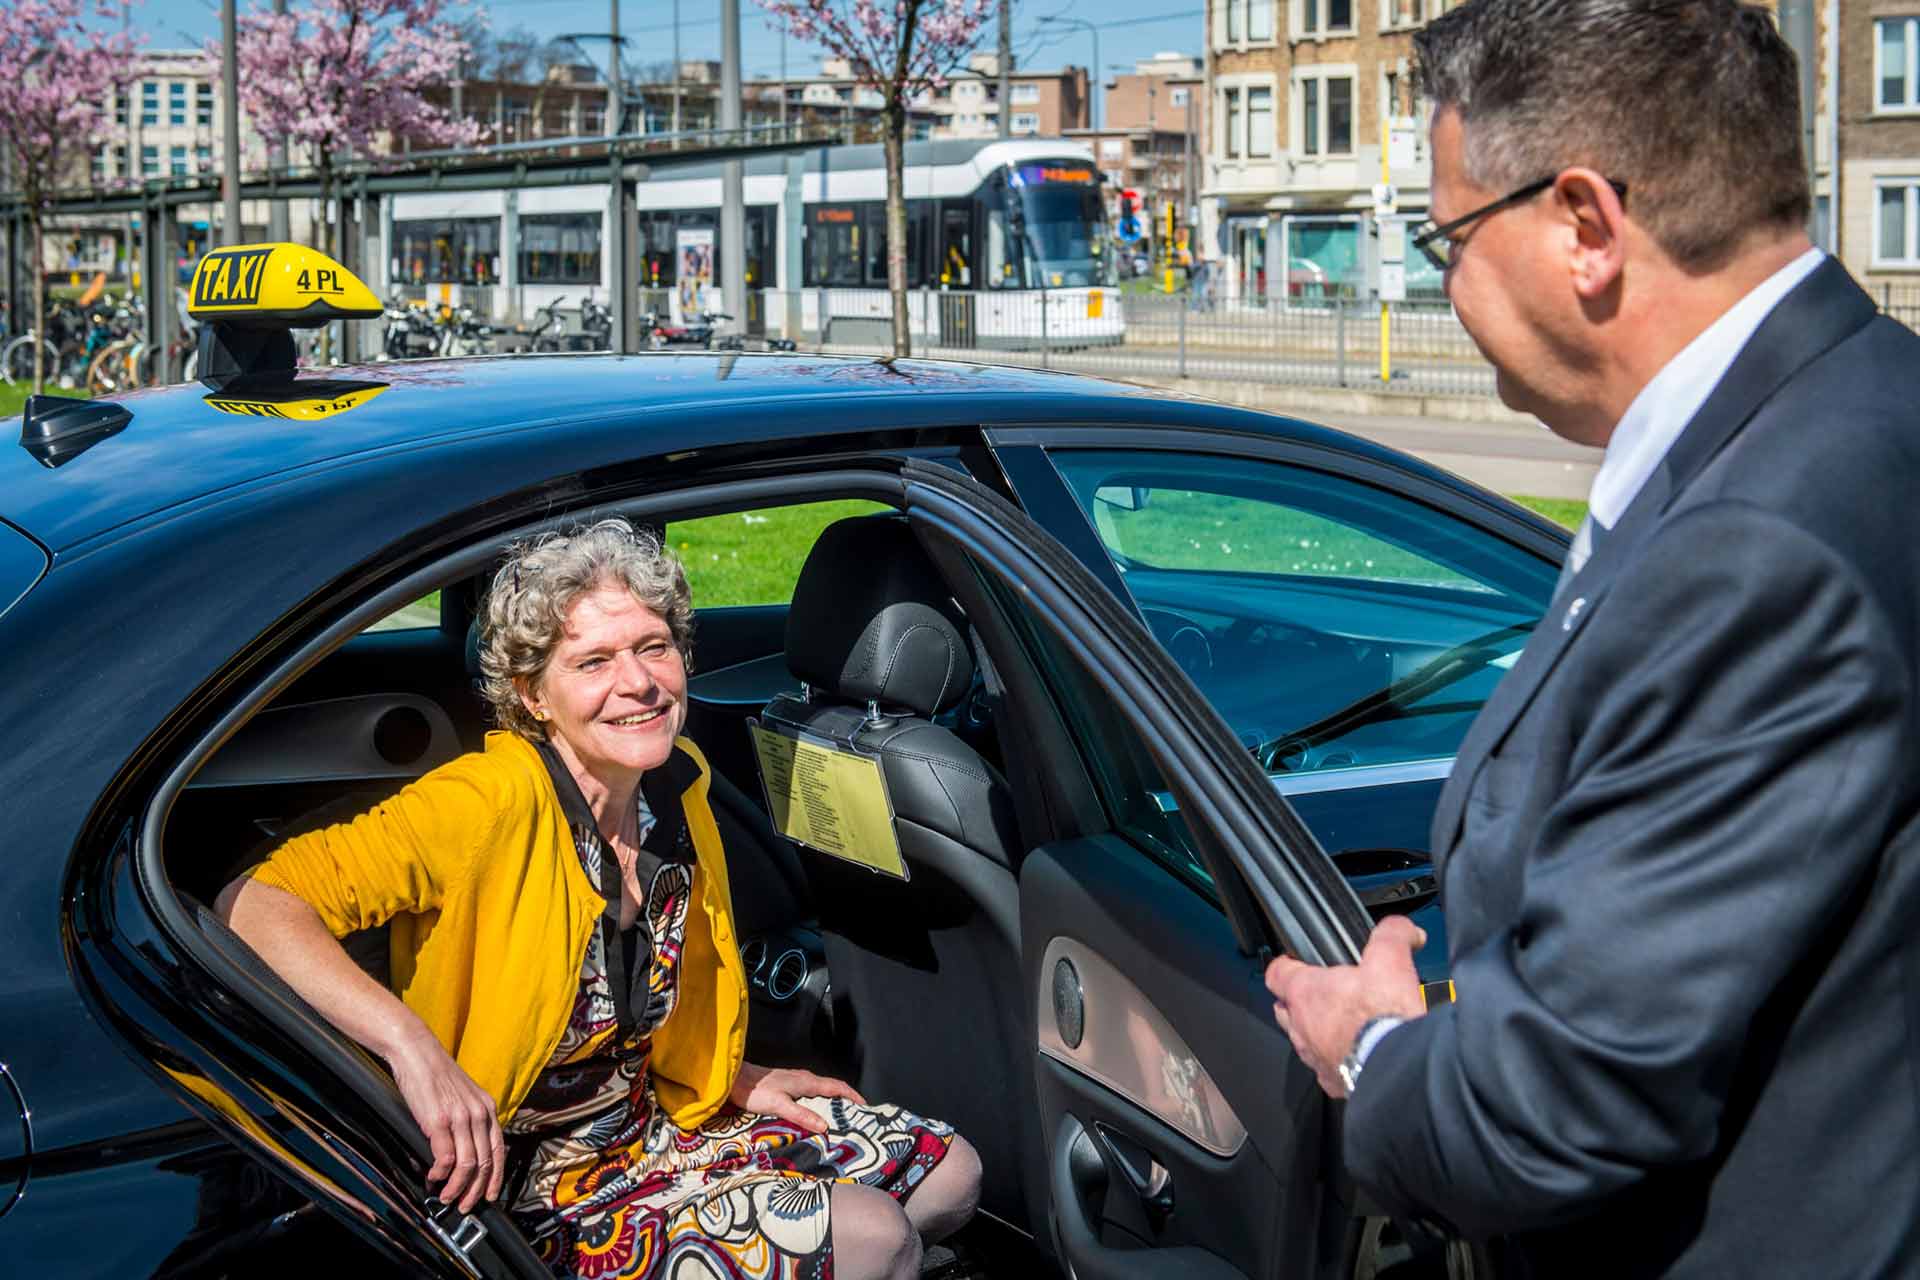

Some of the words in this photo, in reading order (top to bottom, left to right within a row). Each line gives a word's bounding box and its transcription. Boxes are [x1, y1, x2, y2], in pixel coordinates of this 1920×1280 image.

[202, 255, 266, 301] TAXI
[297, 269, 311, 290] 4
[317, 269, 344, 291] PL
